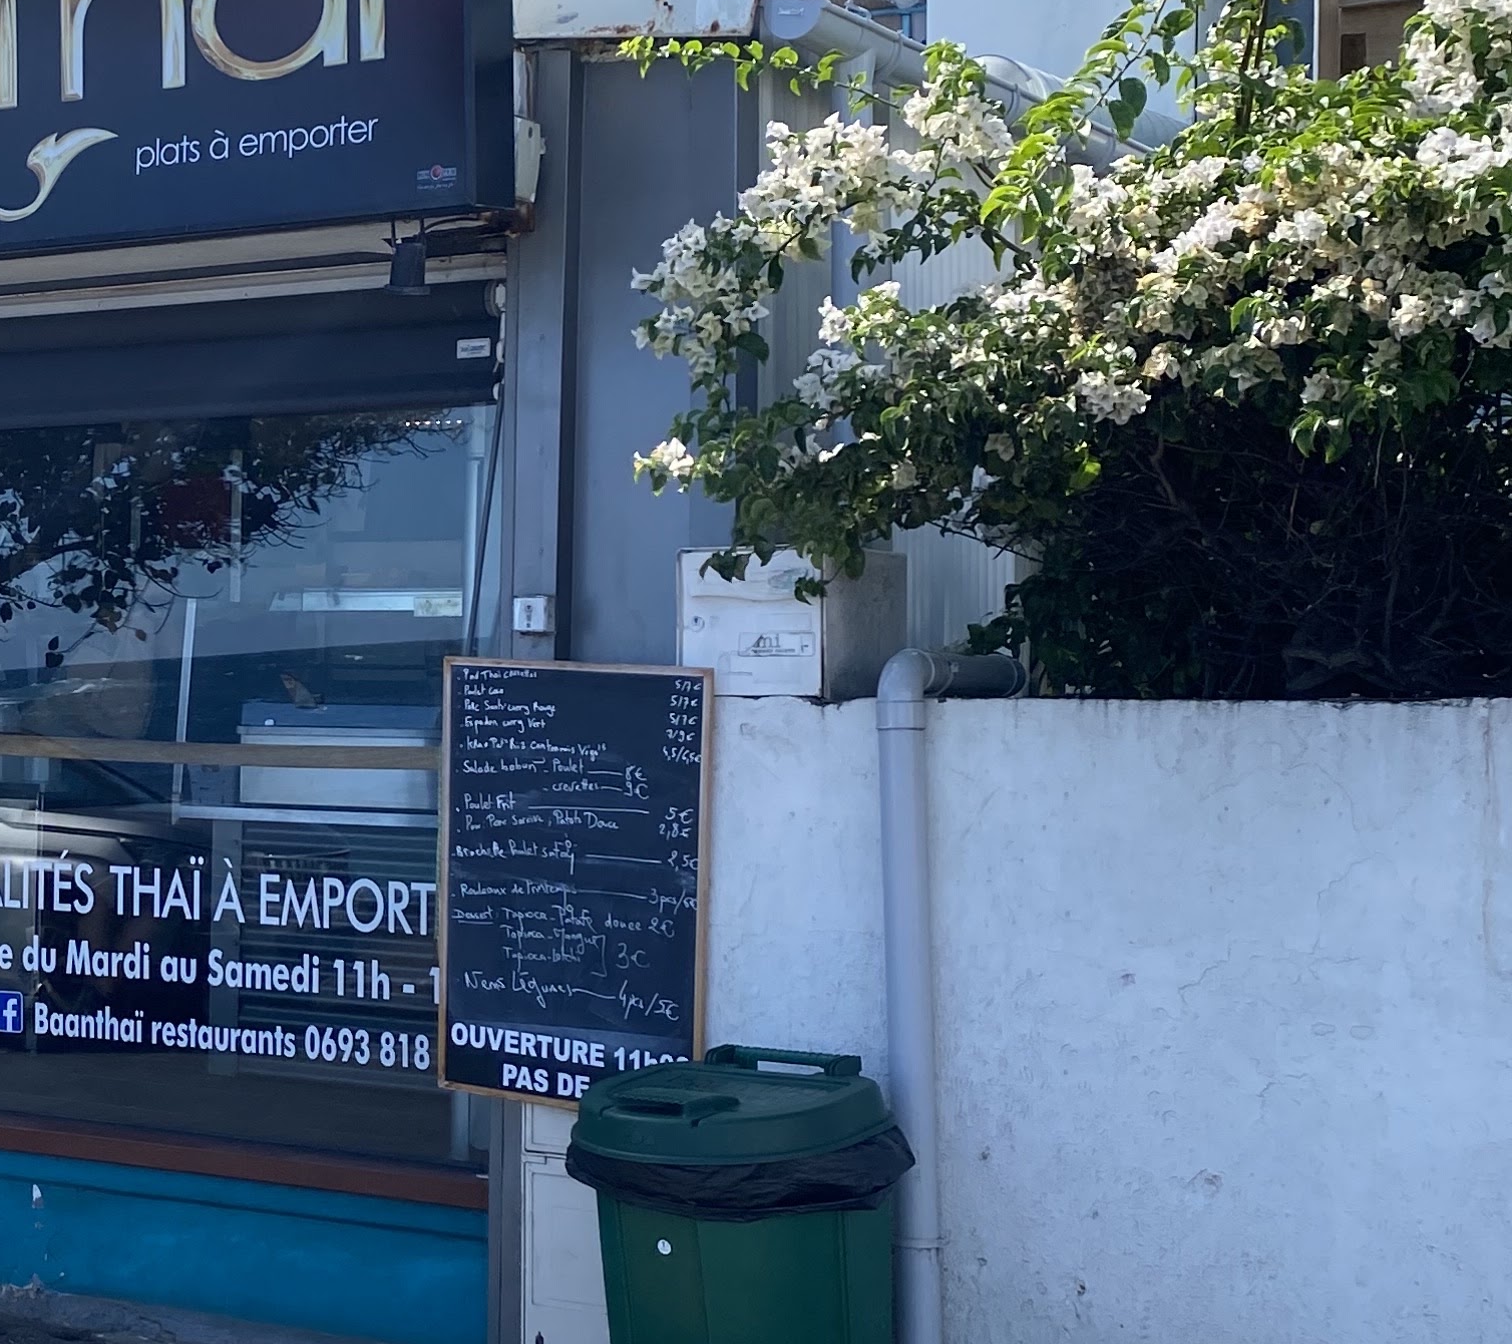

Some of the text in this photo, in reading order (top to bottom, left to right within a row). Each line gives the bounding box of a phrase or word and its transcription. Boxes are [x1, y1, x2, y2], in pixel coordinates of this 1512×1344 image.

[135, 115, 379, 175] plats à emporter
[109, 855, 205, 921] THAÏ
[212, 857, 246, 924] À
[22, 934, 57, 973] du
[65, 939, 151, 980] Mardi
[159, 955, 197, 984] au
[207, 948, 320, 994] Samedi
[333, 958, 391, 1001] 11h
[34, 1001, 144, 1044] Baanthaï
[151, 1018, 296, 1058] restaurants
[304, 1024, 371, 1066] 0693
[379, 1030, 431, 1071] 818
[451, 1022, 690, 1071] OUVERTURE 11h
[502, 1063, 591, 1099] PAS DE
